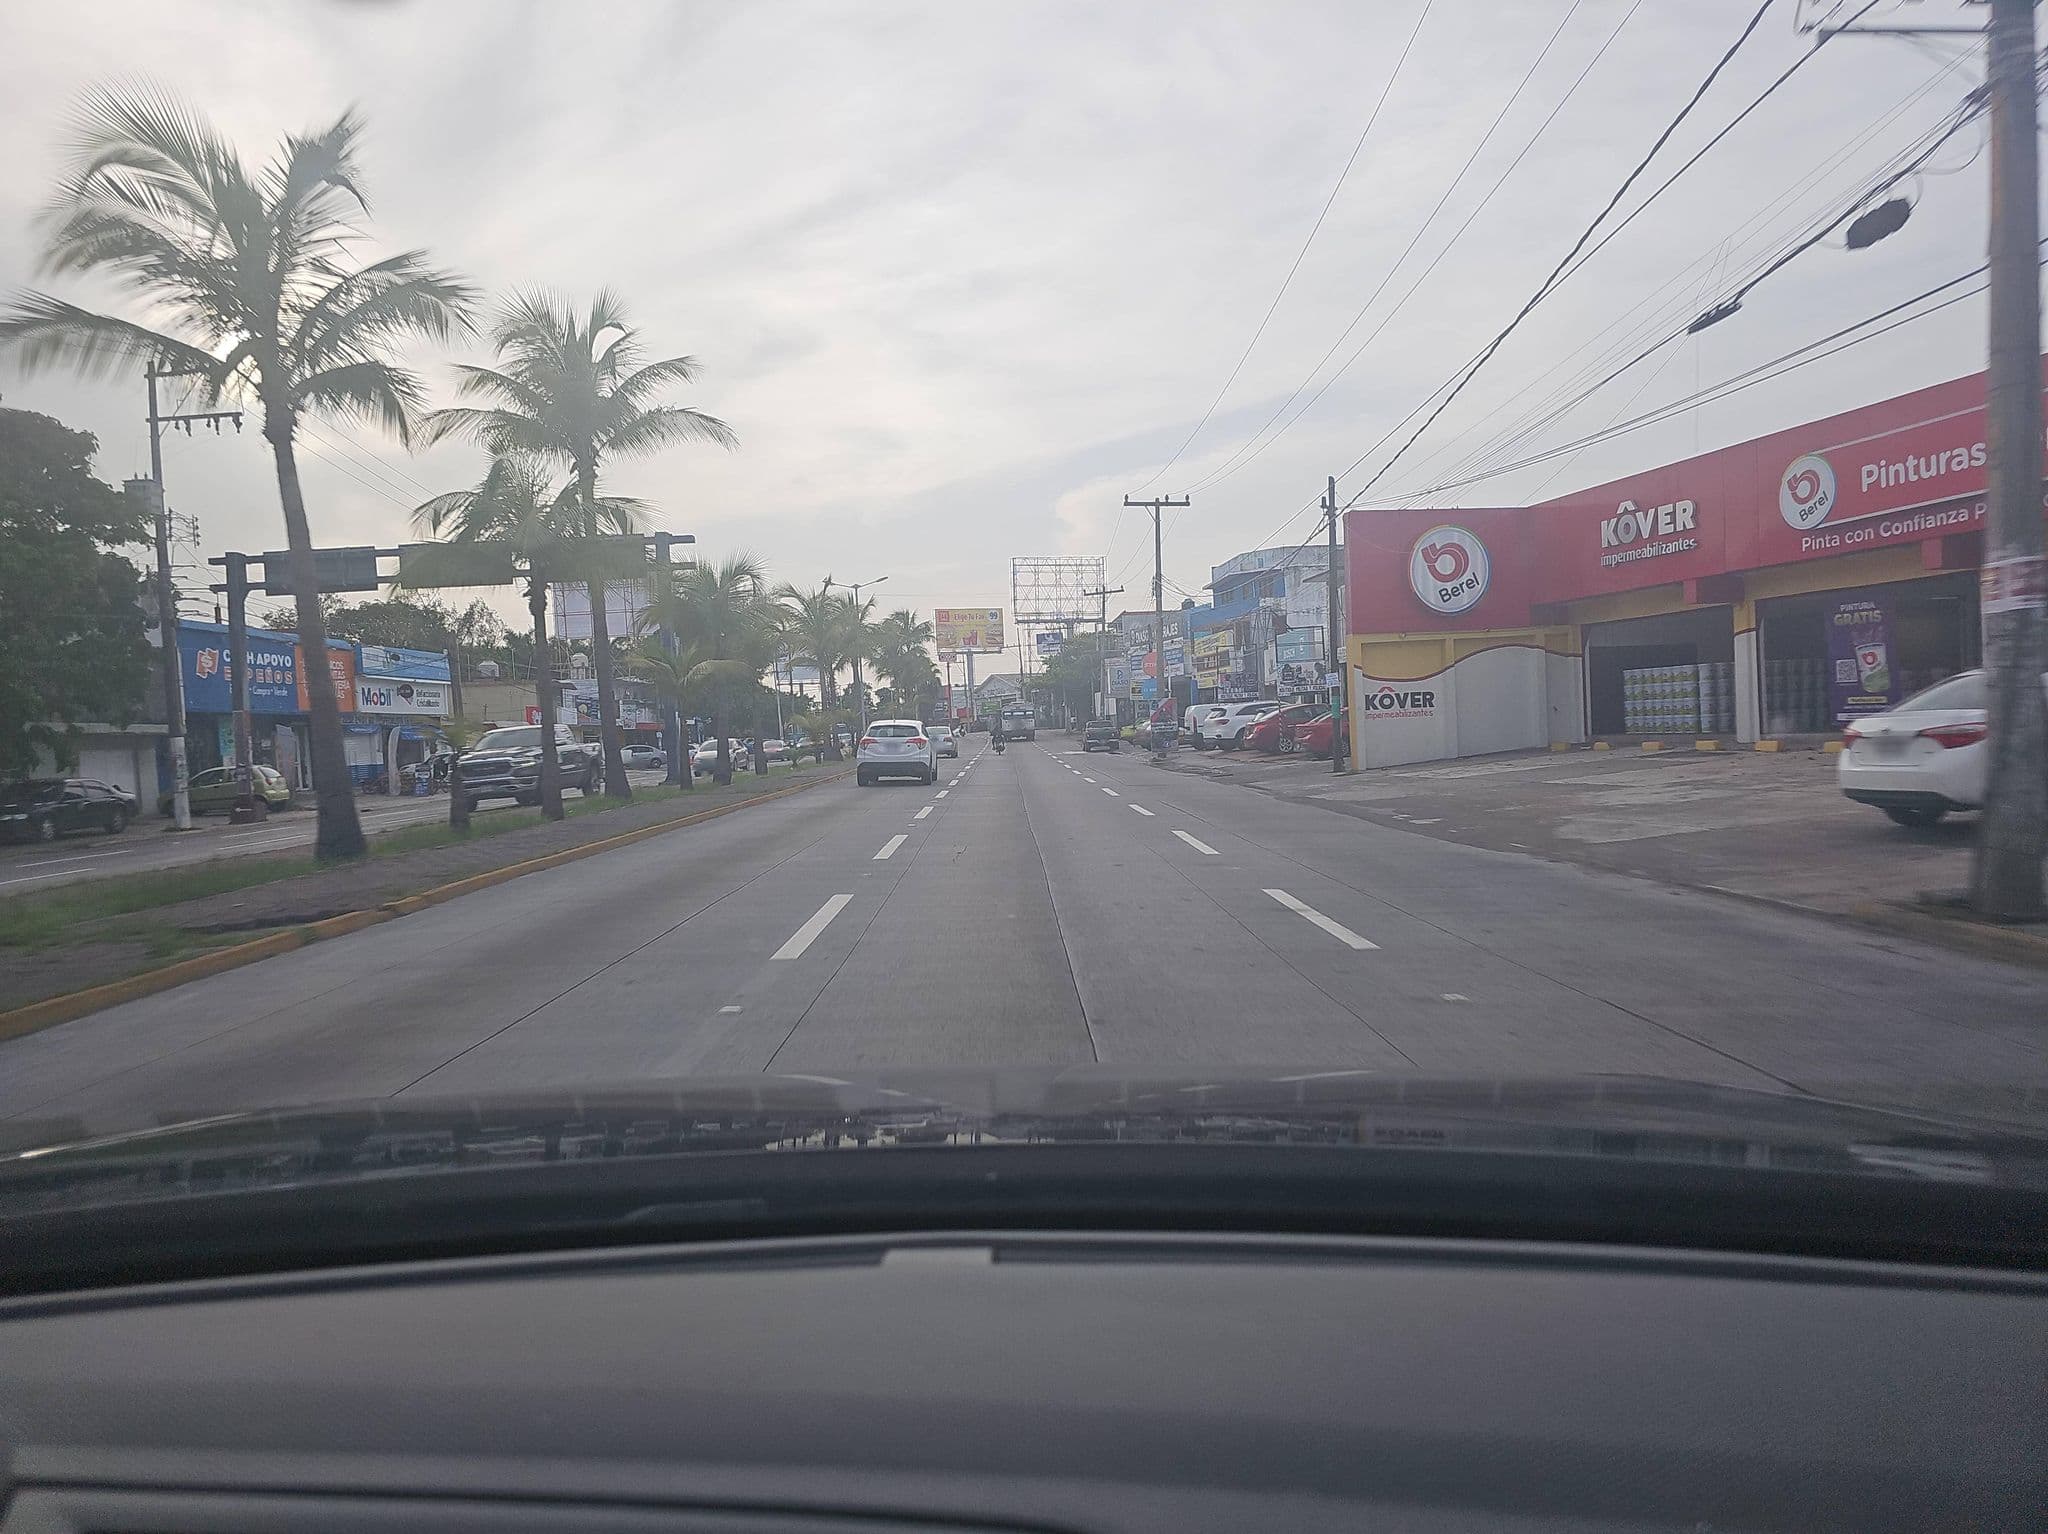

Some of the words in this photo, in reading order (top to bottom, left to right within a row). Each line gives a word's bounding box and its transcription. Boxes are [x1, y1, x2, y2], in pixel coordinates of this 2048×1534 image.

[1861, 441, 1987, 493] Pinturas
[1799, 490, 1829, 522] Berel
[1600, 499, 1696, 548] KÔVER
[1801, 534, 1841, 552] Pinta
[1845, 527, 1875, 544] con
[1879, 507, 1969, 538] Confianza
[1600, 538, 1698, 567] impermeabilizantes
[1438, 571, 1480, 603] Berel
[1834, 610, 1882, 625] GRATIS
[361, 687, 392, 706] Mobil
[1364, 686, 1435, 711] KÔVER
